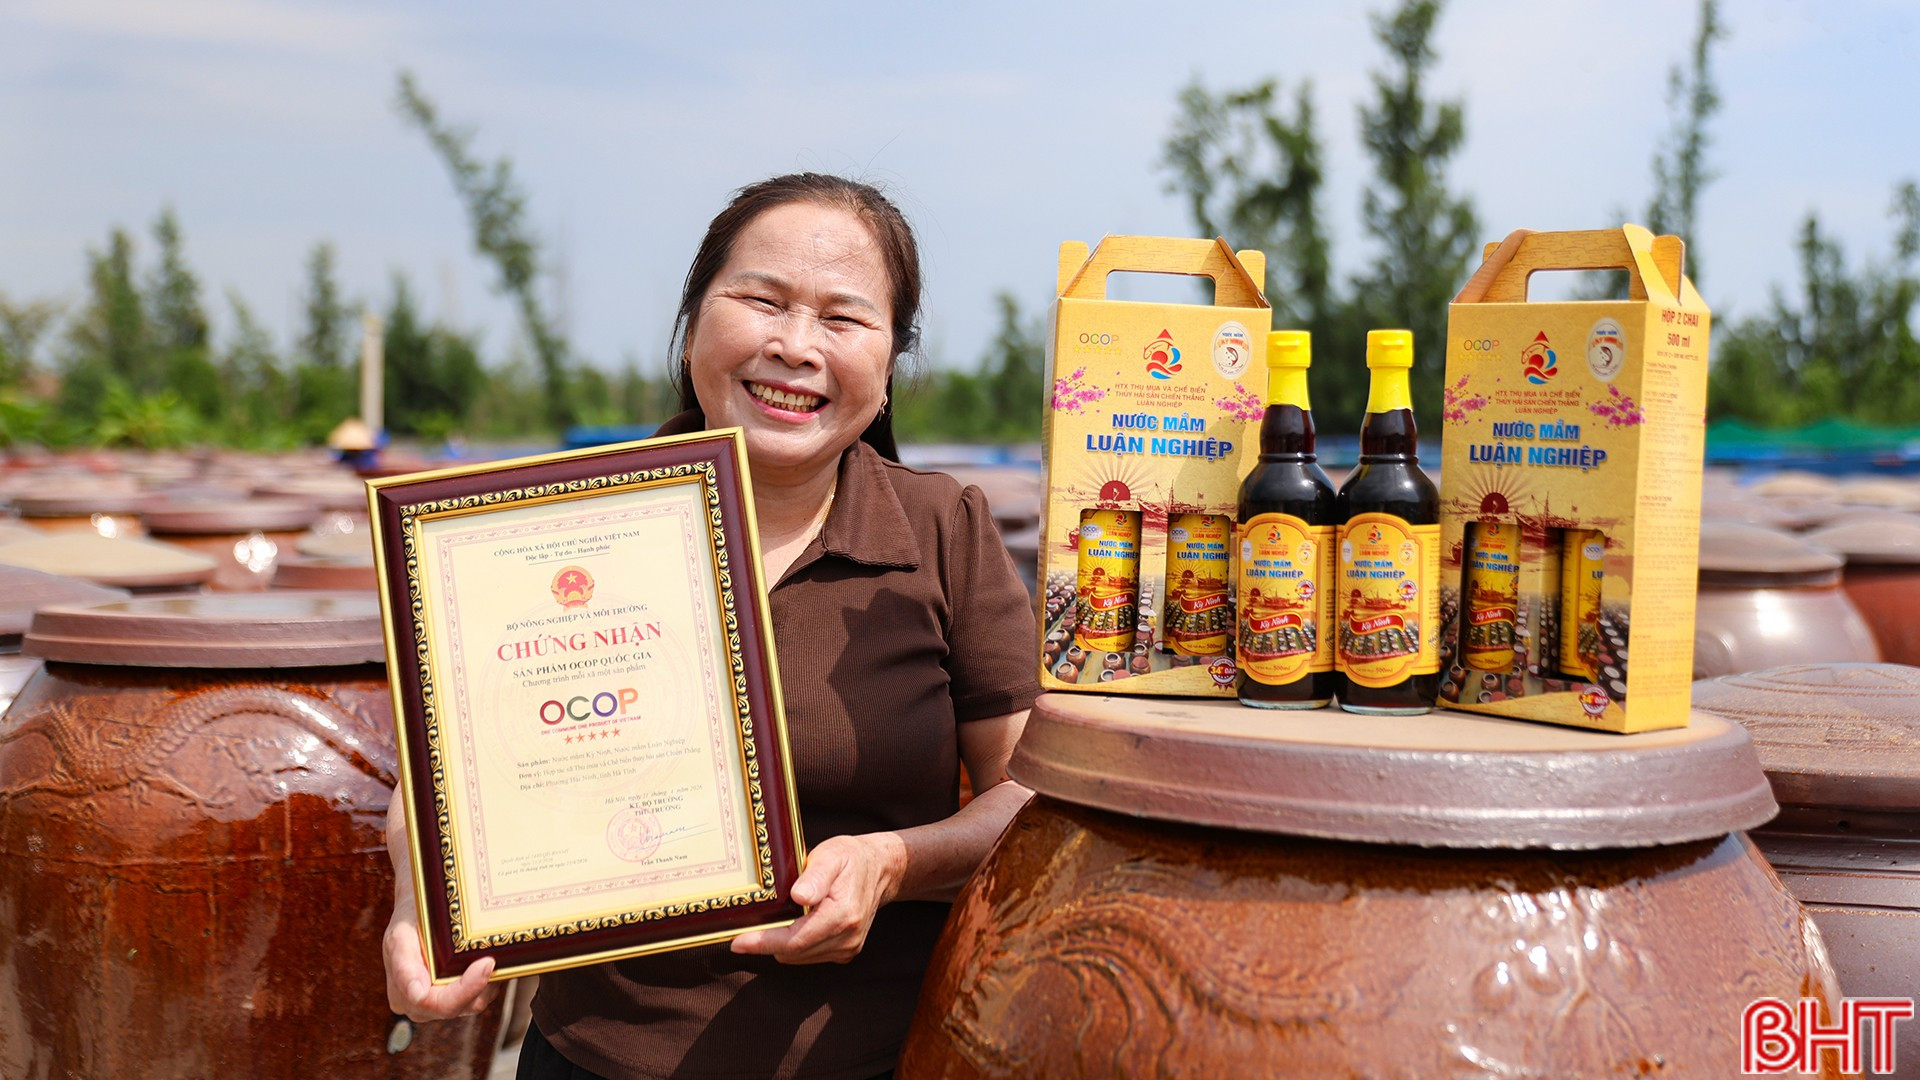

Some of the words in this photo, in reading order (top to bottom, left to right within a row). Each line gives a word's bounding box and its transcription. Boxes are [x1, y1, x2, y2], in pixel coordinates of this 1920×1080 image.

[1677, 312, 1682, 325] 2
[1683, 312, 1699, 327] CHAI
[1080, 333, 1119, 345] OCOP
[1464, 339, 1500, 351] OCOP
[1667, 333, 1680, 347] 500
[1682, 336, 1690, 348] ml
[1162, 384, 1172, 392] VÀ
[1174, 384, 1188, 393] CHẾ
[1190, 385, 1206, 394] BIẾN
[1161, 391, 1181, 400] CHIẾN
[1112, 412, 1158, 430] NƯỚC
[1163, 412, 1205, 432] MẮM
[1493, 420, 1534, 439] NƯỚC
[1539, 418, 1579, 440] MẮM
[1086, 432, 1144, 455] LUẬN
[1151, 436, 1233, 461] NGHIỆP
[1469, 442, 1522, 467] LUẬN
[1528, 445, 1607, 472] NGHIỆP
[493, 548, 515, 556] CỘNG
[546, 541, 560, 549] HỘI
[578, 536, 602, 544] NGHĨA
[1088, 548, 1112, 558] LUẬN
[1176, 550, 1200, 560] LUẬN
[1254, 559, 1272, 567] NƯỚC
[1374, 560, 1393, 568] MẮM
[1486, 563, 1520, 572] NGHIỆP
[1246, 568, 1266, 578] LUẬN
[1269, 570, 1304, 579] NGHIỆP
[1346, 569, 1367, 579] LUẬN
[1370, 570, 1405, 579] NGHIỆP
[1113, 595, 1128, 605] Ninh
[1205, 596, 1221, 607] Ninh
[506, 623, 518, 631] BỘ
[519, 618, 544, 628] NÔNG
[546, 615, 578, 625] NGHIỆP
[579, 611, 591, 619] VÀ
[592, 609, 610, 617] MÔI
[611, 603, 647, 614] TRƯỜNG
[1271, 615, 1288, 626] Ninh
[1373, 616, 1391, 628] Ninh
[497, 633, 586, 662] CHỨNG
[593, 621, 662, 648] NHẬN
[512, 667, 533, 678] SẢN
[535, 662, 566, 674] PHẨM
[568, 659, 598, 670] OCOP
[599, 653, 631, 666] QUỐC
[632, 651, 651, 660] GIA
[521, 678, 551, 688] Chương
[552, 675, 569, 683] trình
[570, 671, 585, 680] mỗi
[596, 668, 611, 677] một
[612, 666, 624, 674] sản
[625, 663, 646, 673] phẩm
[539, 687, 639, 726] OCOP
